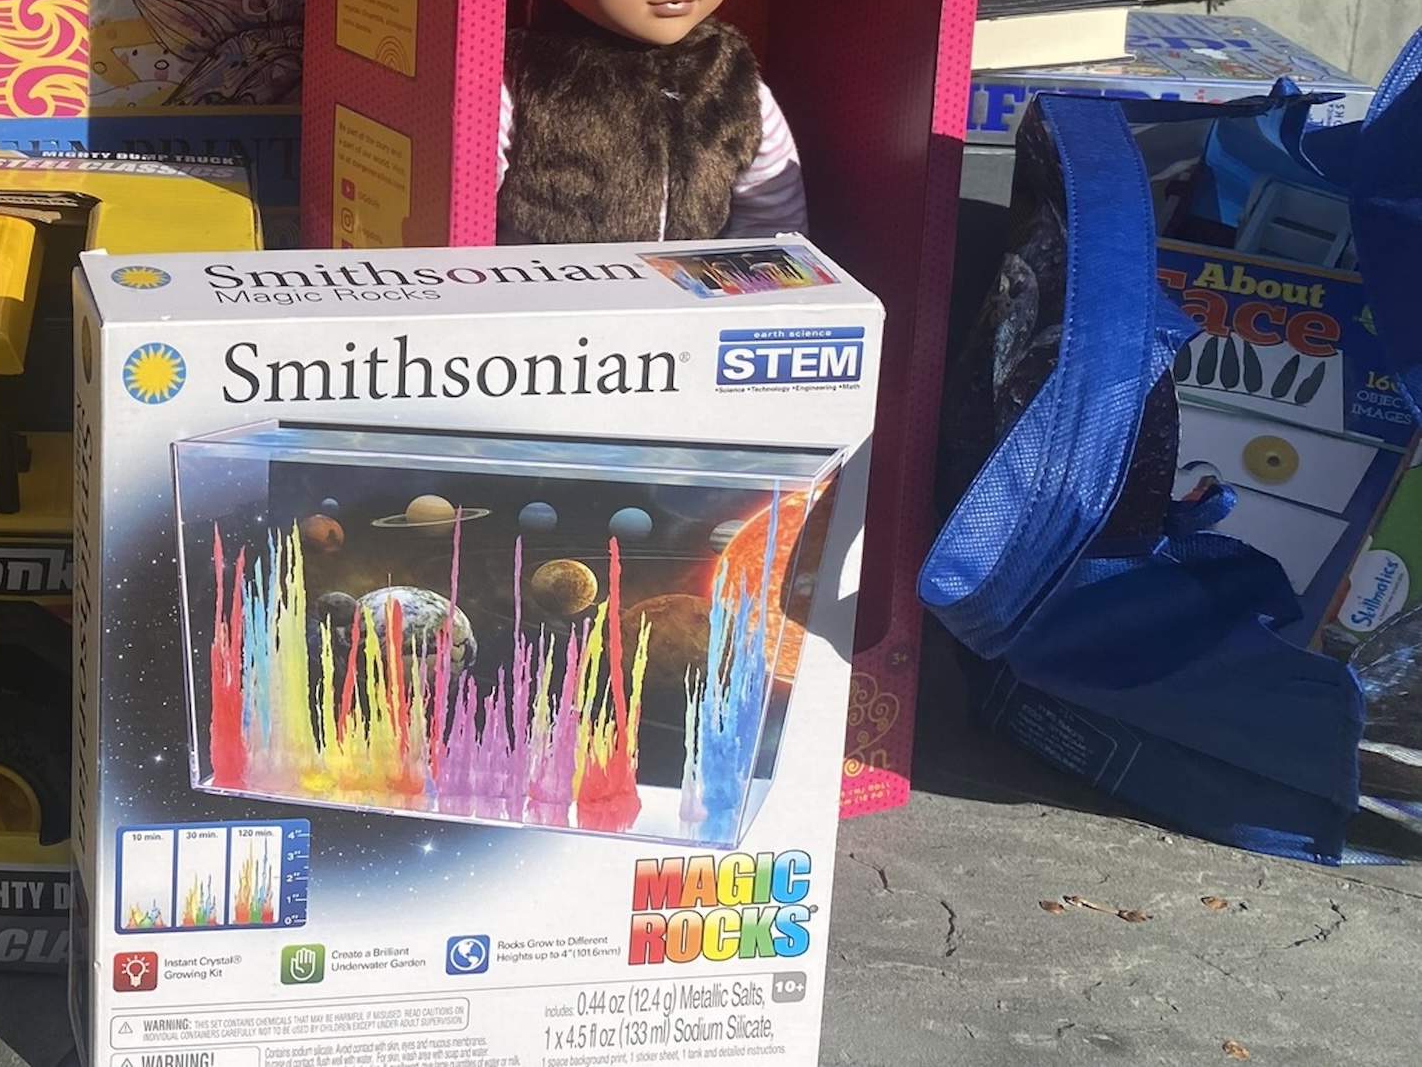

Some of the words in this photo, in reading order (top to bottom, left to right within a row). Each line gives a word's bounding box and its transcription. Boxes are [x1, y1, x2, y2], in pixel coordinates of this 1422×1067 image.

[42, 150, 112, 159] MIGHTY
[116, 151, 169, 161] DUMP
[173, 154, 236, 165] TRUCK
[78, 160, 235, 178] CLASSICS
[203, 259, 649, 290] Smithsonian
[1195, 261, 1327, 310] About
[214, 289, 323, 305] Magic
[335, 286, 441, 303] Rocks
[753, 330, 785, 339] earth
[788, 329, 832, 338] science
[222, 334, 680, 405] Smithsonian
[722, 345, 858, 381] STEM
[1356, 389, 1405, 410] OBJEC
[1351, 403, 1412, 426] IMAGES
[1351, 559, 1399, 627] Skillmatics
[892, 652, 908, 665] 3+
[131, 833, 142, 841] 10
[186, 831, 197, 839] 30
[238, 829, 253, 837] 120
[632, 849, 812, 912] MAGIC
[497, 939, 525, 950] Rocks
[527, 937, 554, 949] Grow
[555, 937, 566, 947] to
[567, 935, 609, 946] Different
[628, 904, 812, 966] ROCKS
[164, 956, 197, 968] Instant
[331, 948, 362, 960] Create
[373, 946, 410, 957] Brilliant
[496, 951, 532, 964] Heights
[534, 951, 547, 962] up
[548, 948, 560, 960] to
[331, 958, 380, 972] Underwater
[381, 957, 426, 969] Garden
[163, 968, 207, 981] Growing
[208, 968, 223, 979] Kit
[775, 980, 805, 993] 10+
[577, 990, 607, 1017] 0.44
[608, 995, 625, 1015] oz
[628, 984, 661, 1017] (12.4
[663, 982, 678, 1018] g)
[679, 982, 729, 1011] Metallic
[730, 981, 766, 1010] Salts,
[143, 1017, 192, 1032] WARNING:
[194, 1020, 209, 1029] THIS
[210, 1019, 223, 1028] SET
[223, 1018, 255, 1028] CONTAINS
[255, 1015, 292, 1026] CHEMICALS
[293, 1014, 310, 1024] THAT
[310, 1013, 325, 1023] MAY
[545, 1026, 551, 1050] 1
[554, 1032, 563, 1050] x
[565, 1024, 587, 1050] 4.5
[589, 1023, 598, 1048] fl
[599, 1028, 616, 1048] oz
[618, 1017, 648, 1050] (133
[649, 1015, 671, 1049] ml)
[674, 1016, 724, 1044] Sodium
[726, 1014, 774, 1041] Silicate,
[634, 1049, 658, 1063] sticker
[659, 1049, 680, 1062] sheet,
[687, 1047, 703, 1059] tank
[704, 1046, 717, 1058] and
[718, 1045, 746, 1058] detailed
[746, 1043, 786, 1057] instructions.
